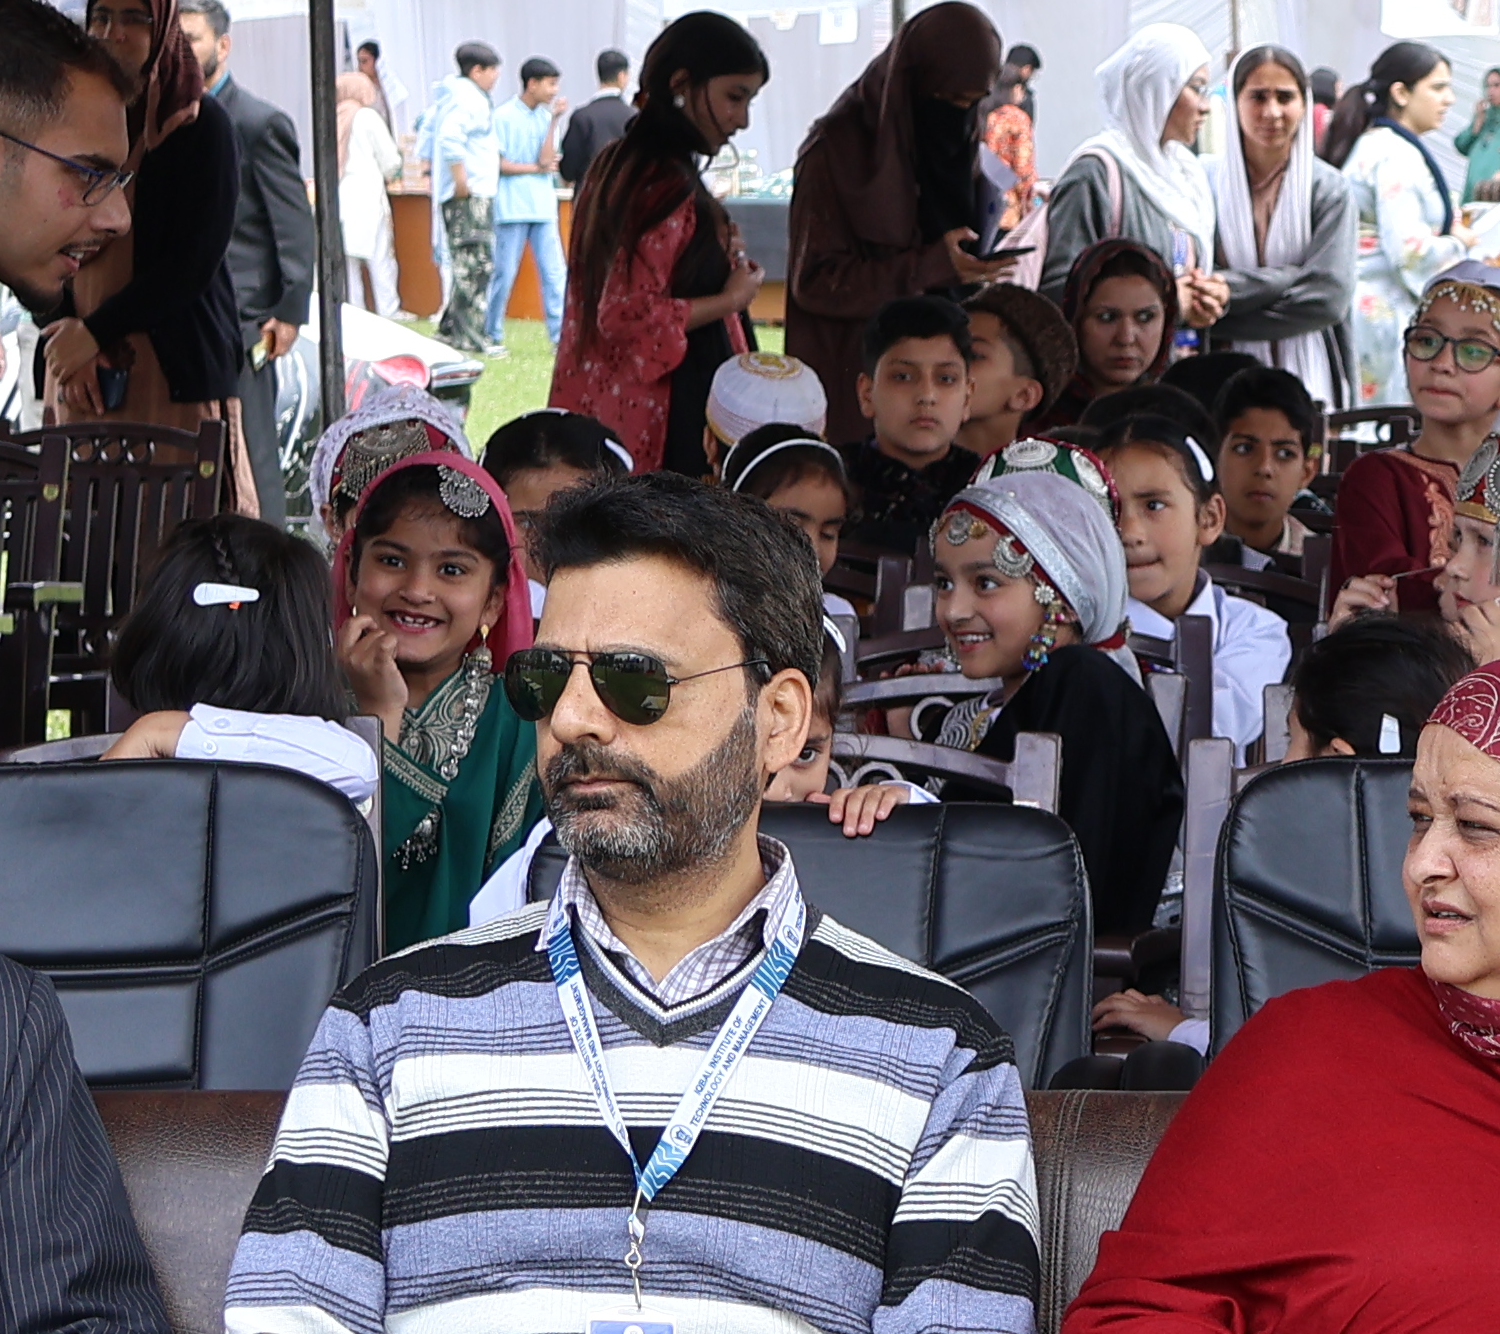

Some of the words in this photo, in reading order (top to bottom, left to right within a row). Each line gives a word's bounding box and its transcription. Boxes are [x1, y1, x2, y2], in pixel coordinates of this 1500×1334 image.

[568, 1013, 579, 1027] OF
[569, 981, 594, 1039] MANAGEMENT
[572, 1027, 594, 1070] INSTITUTE
[586, 1039, 598, 1058] AND
[689, 1070, 726, 1128] TECHNOLOGY
[721, 1051, 737, 1072] AND
[731, 997, 769, 1053] MANAGEMENT
[692, 1067, 713, 1096] IQBAL
[707, 1027, 737, 1069] INSTITUTE
[731, 1014, 744, 1029] OF
[592, 1058, 618, 1119] TECHNOLOGY
